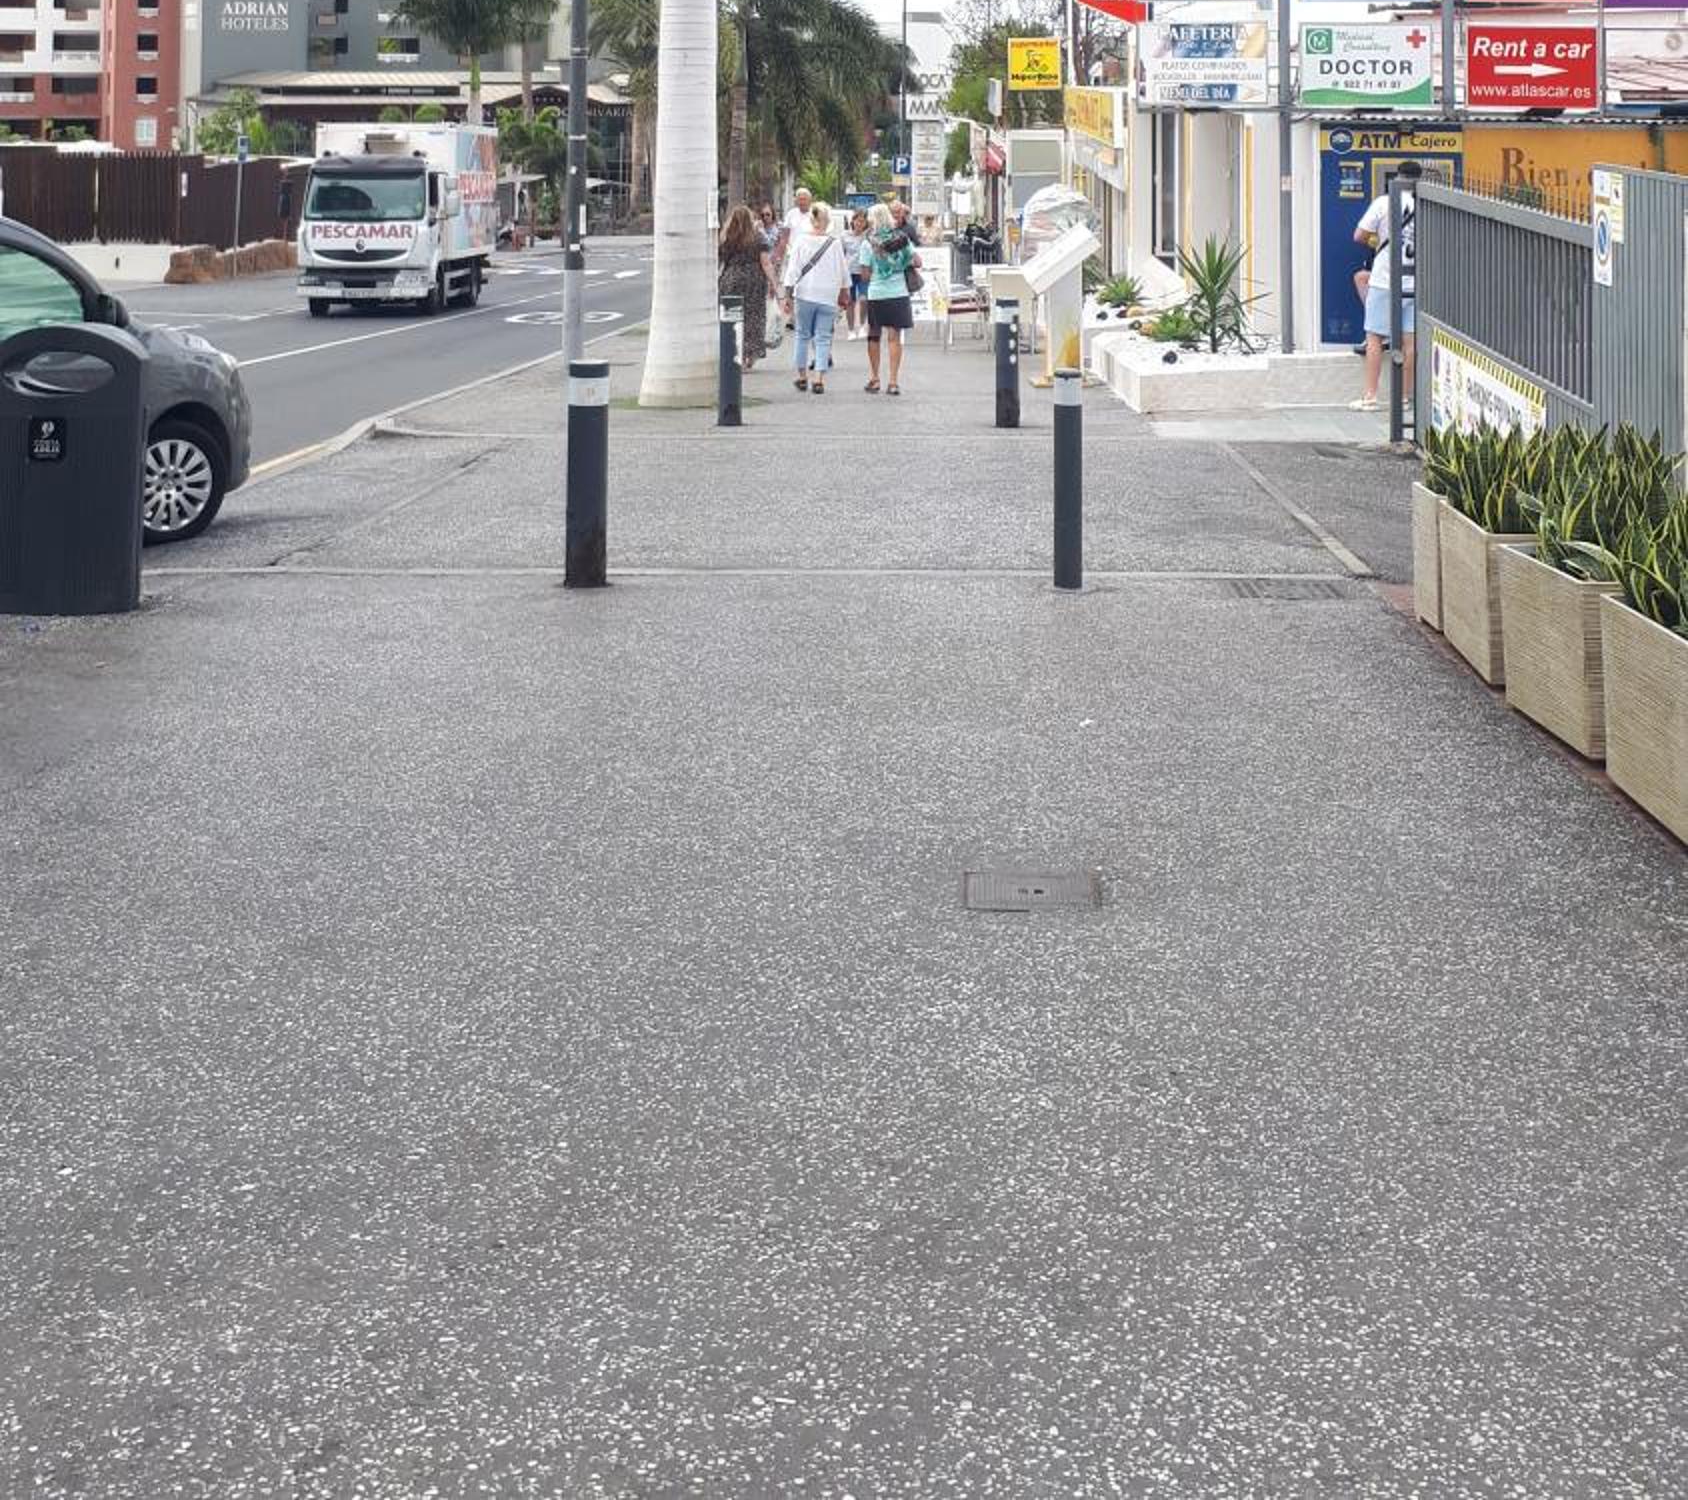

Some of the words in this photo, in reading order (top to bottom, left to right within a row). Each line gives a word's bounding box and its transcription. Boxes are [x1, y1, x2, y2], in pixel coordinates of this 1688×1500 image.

[223, 1, 288, 15] ADRIAN
[221, 17, 288, 30] HOTELES
[1472, 36, 1528, 58] Rent
[1533, 42, 1546, 58] a
[1553, 42, 1592, 59] car
[1319, 59, 1413, 75] DOCTOR
[1471, 82, 1591, 99] www.atlascar.es
[1358, 133, 1401, 149] ATM
[1409, 134, 1457, 150] Cajero
[311, 224, 413, 239] PESCAMAR
